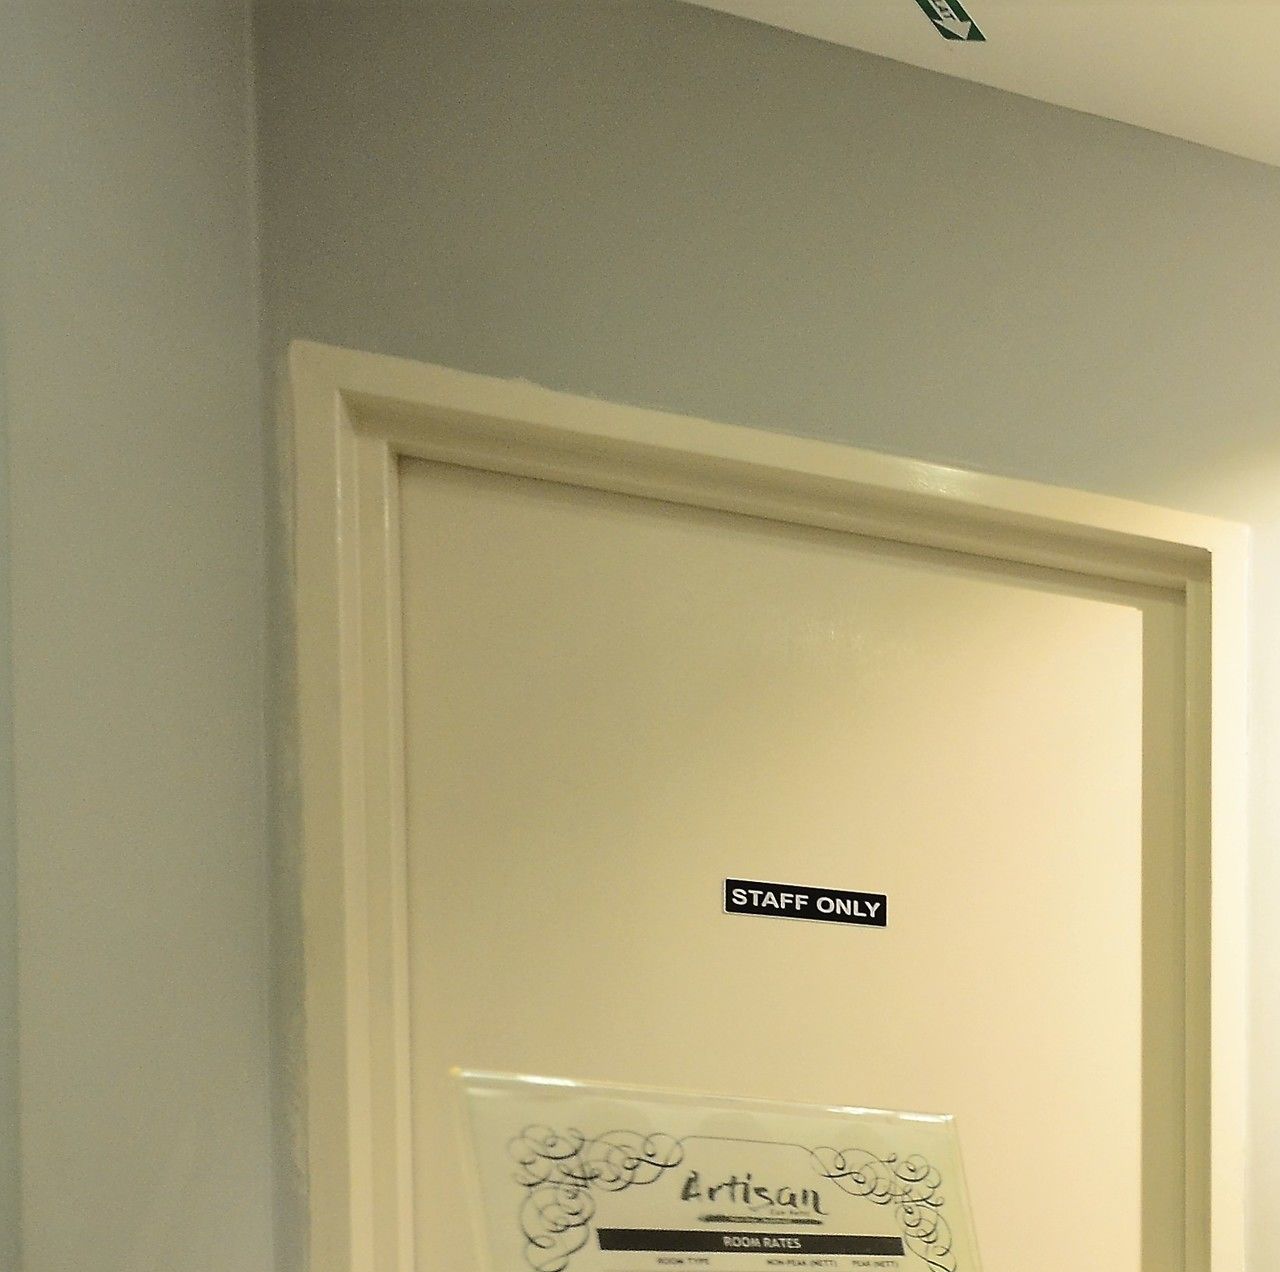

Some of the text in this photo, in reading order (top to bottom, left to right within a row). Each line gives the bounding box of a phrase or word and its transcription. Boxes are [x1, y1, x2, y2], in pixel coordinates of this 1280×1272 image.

[732, 889, 881, 918] STAFF ONLY
[681, 1170, 829, 1215] Artisan
[723, 1236, 802, 1249] ROOM RATES
